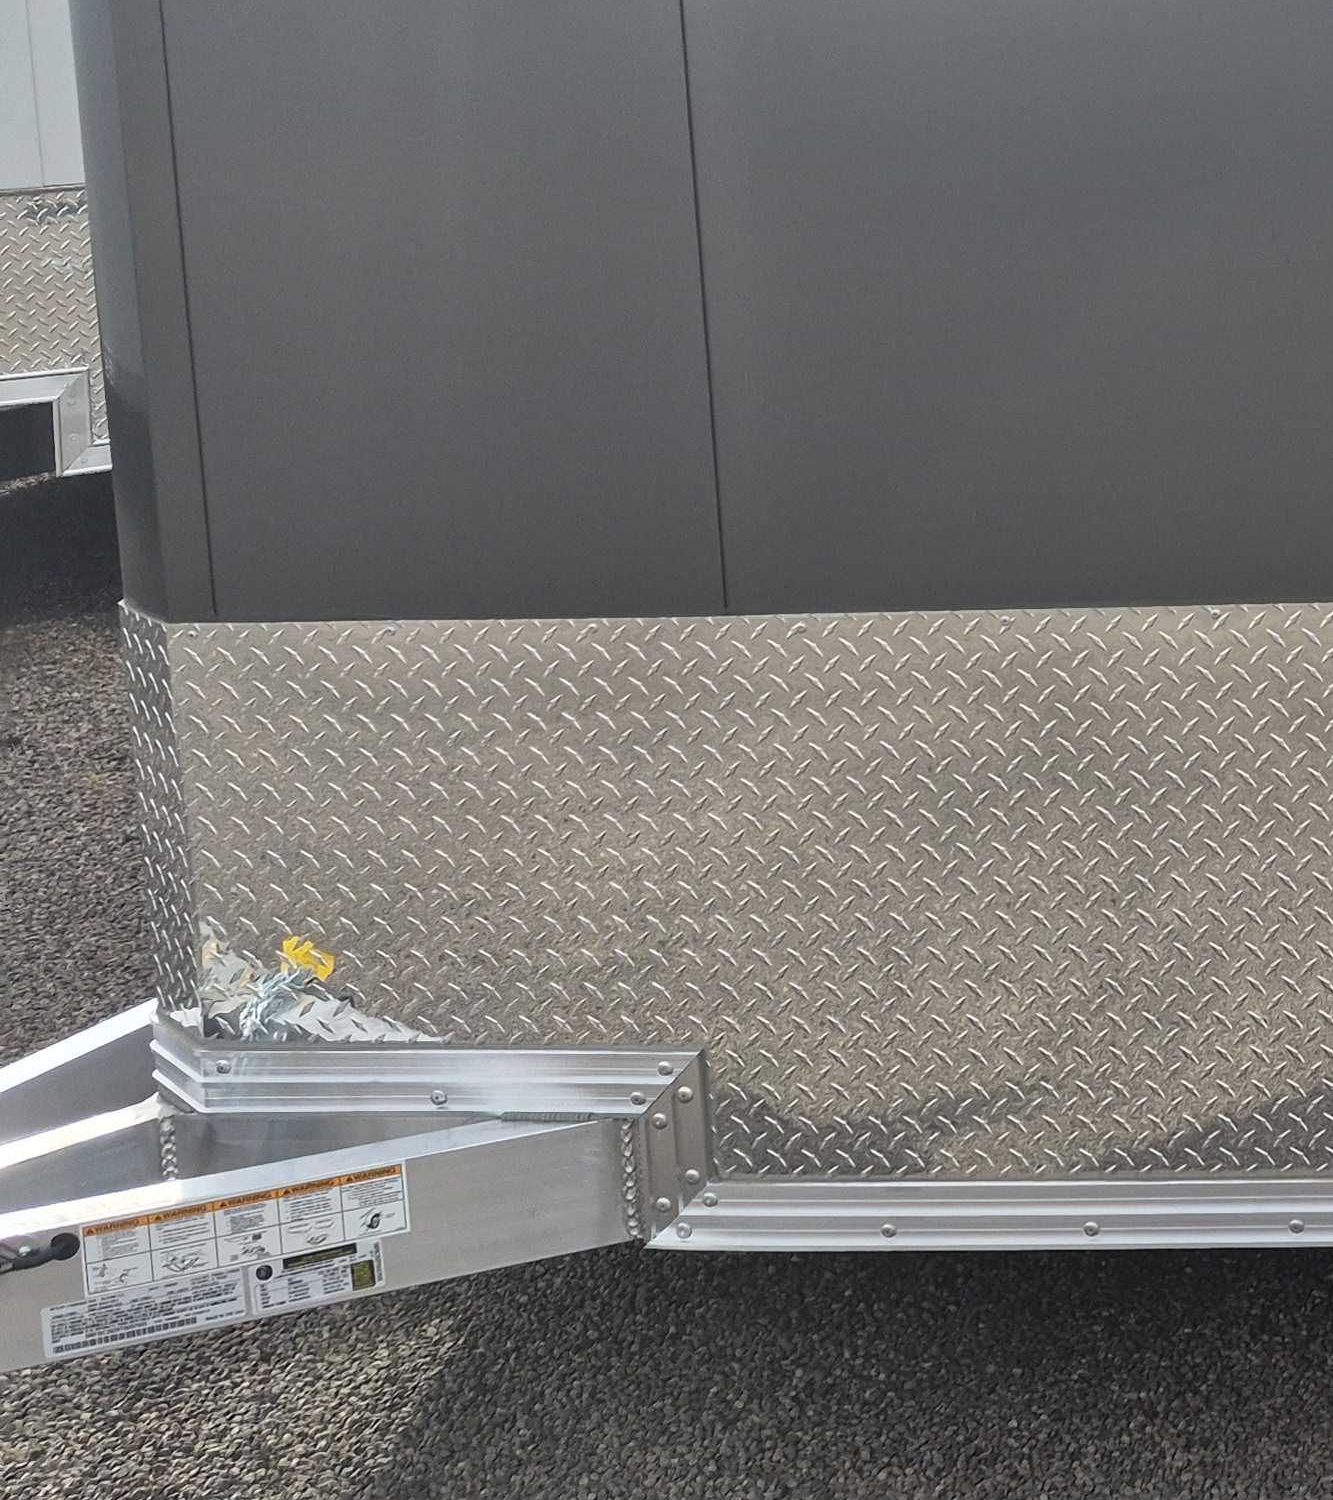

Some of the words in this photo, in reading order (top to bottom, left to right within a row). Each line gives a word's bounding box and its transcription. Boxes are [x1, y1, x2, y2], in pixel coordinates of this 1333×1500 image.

[352, 1167, 397, 1181] WARNING
[291, 1180, 334, 1193] WARNING
[227, 1192, 272, 1206] WARNING
[163, 1205, 208, 1220] WARNING
[94, 1219, 140, 1234] WARNING
